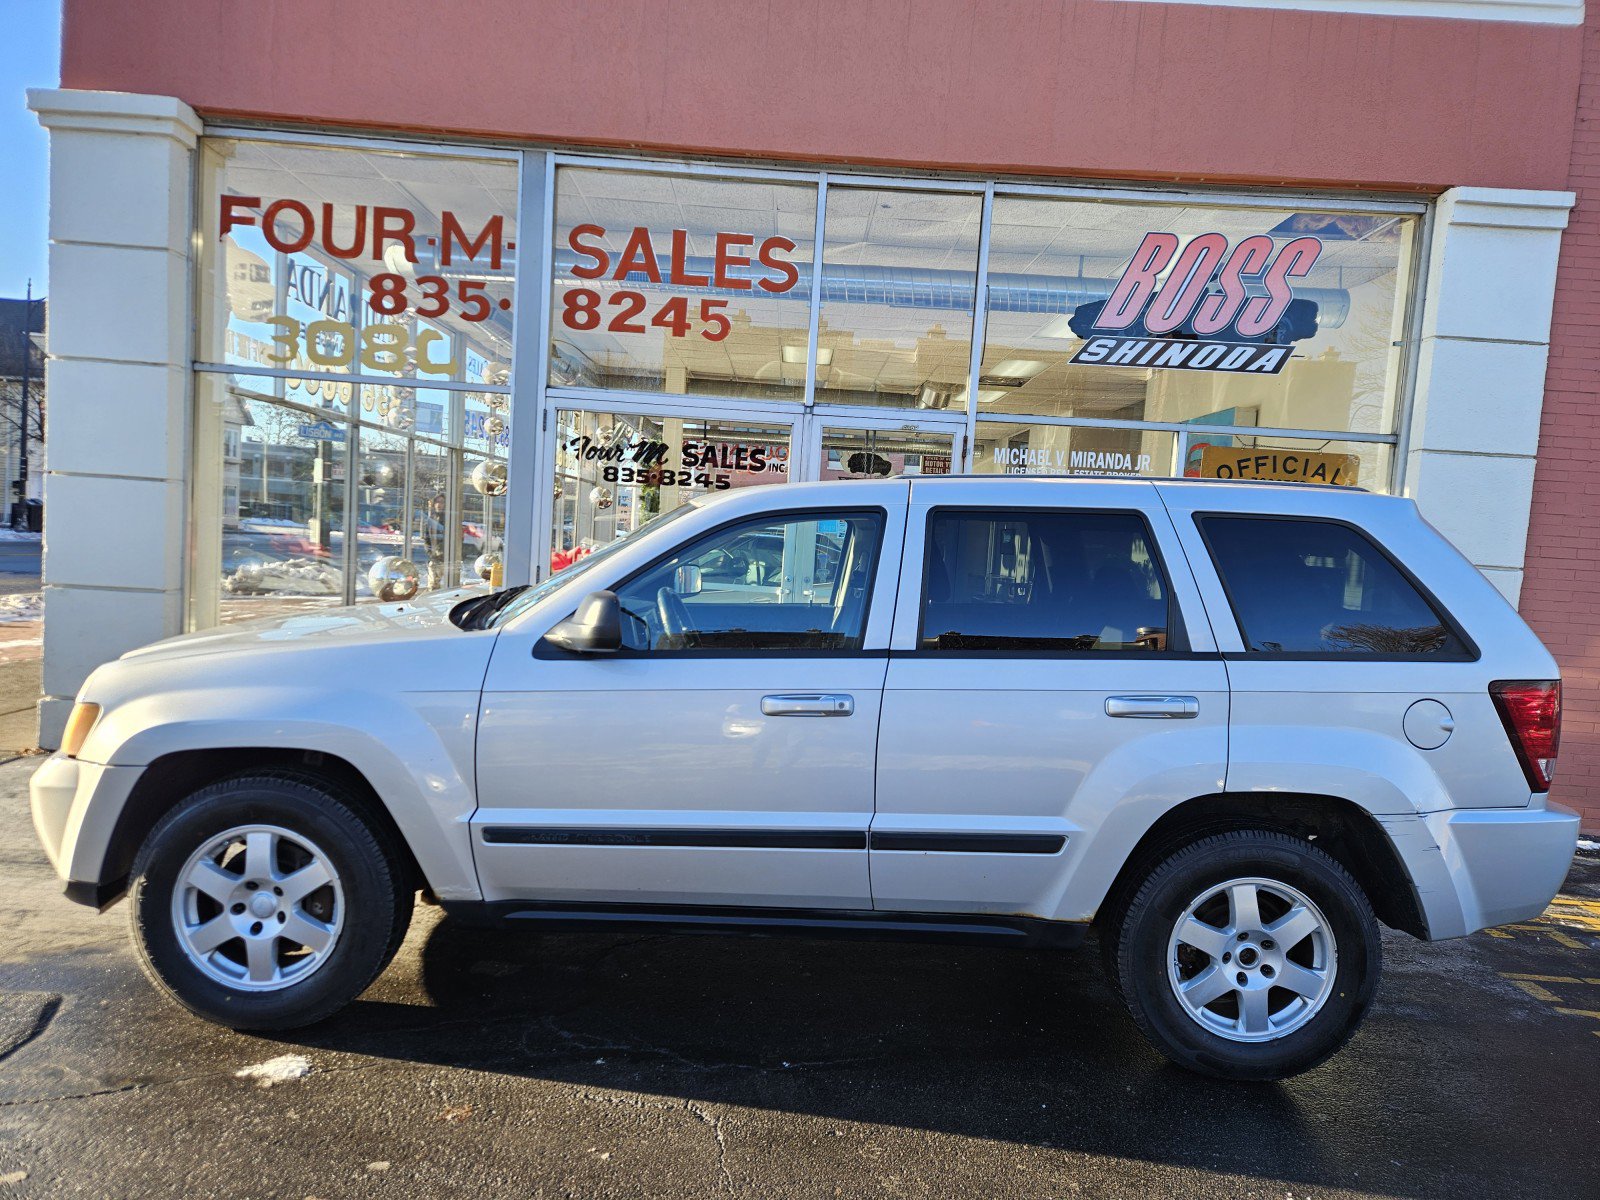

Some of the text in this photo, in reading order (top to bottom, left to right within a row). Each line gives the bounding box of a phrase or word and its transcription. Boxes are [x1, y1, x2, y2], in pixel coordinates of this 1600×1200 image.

[568, 223, 800, 293] SALES
[1091, 230, 1323, 338] BOSS
[562, 288, 732, 342] 8245
[1078, 338, 1288, 373] SHINODA
[301, 425, 332, 438] LISBON
[562, 436, 626, 462] Four
[681, 443, 767, 472] SALES
[993, 447, 1052, 466] MICHAEL
[1070, 451, 1132, 470] MIRANDA
[1216, 455, 1343, 486] OFFICIAL
